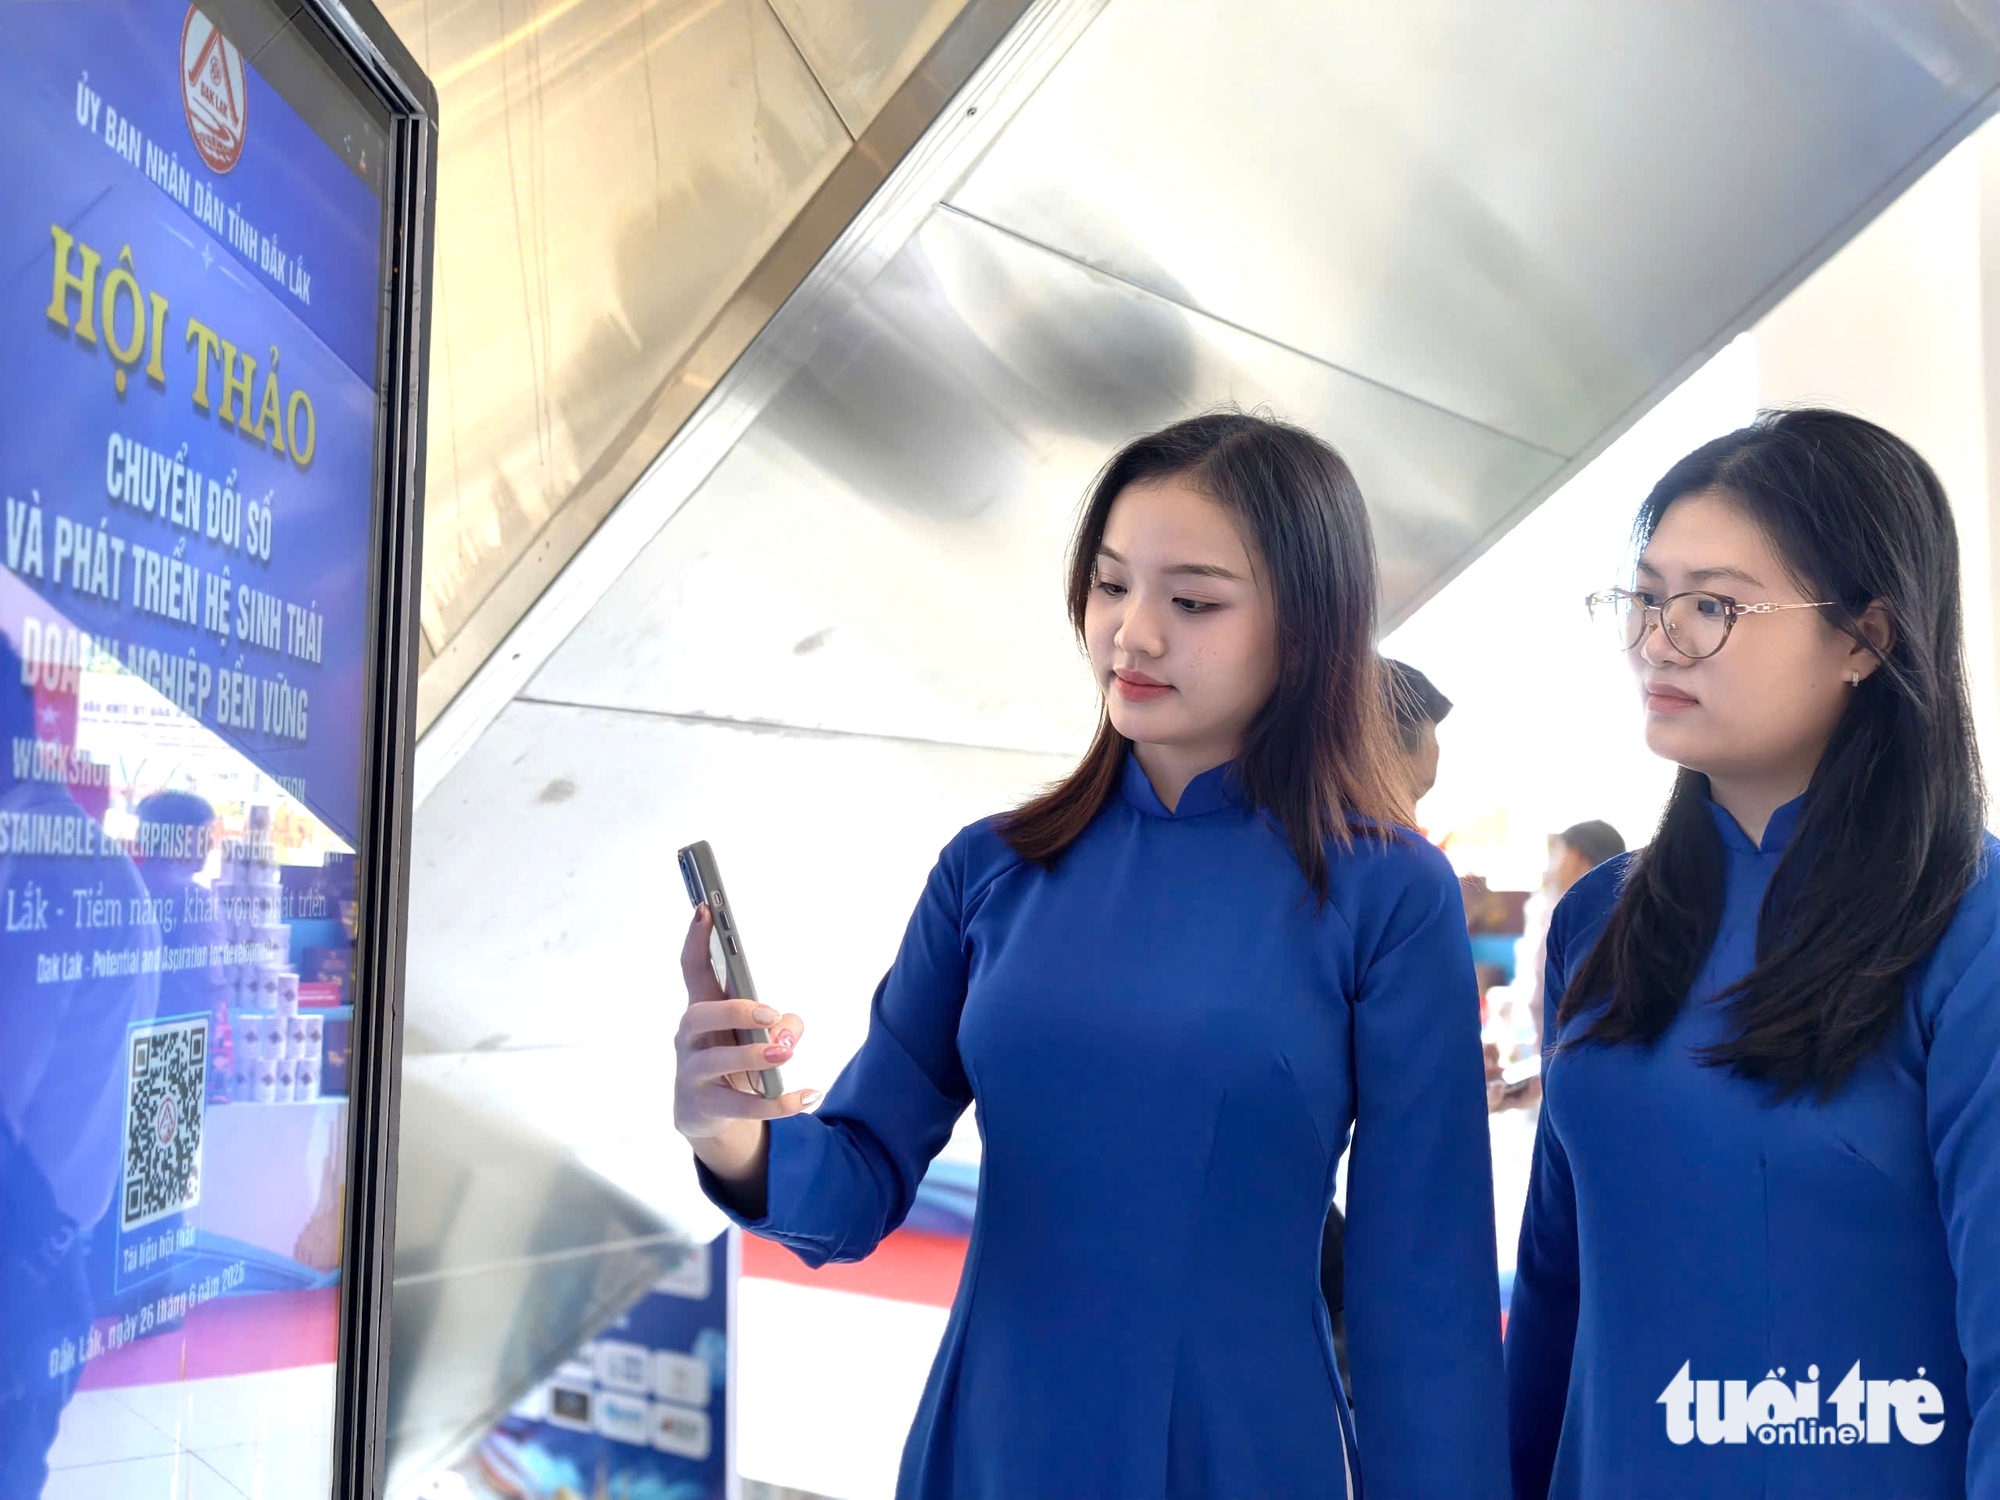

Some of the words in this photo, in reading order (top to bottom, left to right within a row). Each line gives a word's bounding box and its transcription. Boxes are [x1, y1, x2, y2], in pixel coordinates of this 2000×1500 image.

[76, 70, 102, 134] ỦY
[105, 104, 142, 169] BAN
[145, 138, 191, 209] NHÂN
[194, 180, 225, 236] DÂN
[227, 202, 259, 263] TỈNH
[260, 233, 287, 287] ĐẮK
[289, 254, 311, 306] LẮK
[46, 221, 169, 393] HỘI
[185, 316, 316, 466] THẢO
[106, 431, 203, 533] CHUYỂN
[206, 468, 243, 549] ĐỔI
[246, 490, 274, 562] SỐ
[5, 489, 44, 578] VÀ
[53, 517, 125, 602] PHÁT
[132, 537, 200, 627] TRIỂN
[204, 566, 232, 648] HỆ
[236, 584, 282, 652] SINH
[287, 601, 323, 665] THÁI
[216, 654, 256, 732] BỀN
[262, 673, 309, 741] VỮNG
[6, 880, 49, 932] Lắk
[62, 952, 83, 981] Lak
[92, 949, 140, 978] Potential
[141, 947, 160, 974] and
[188, 1283, 196, 1309] 6
